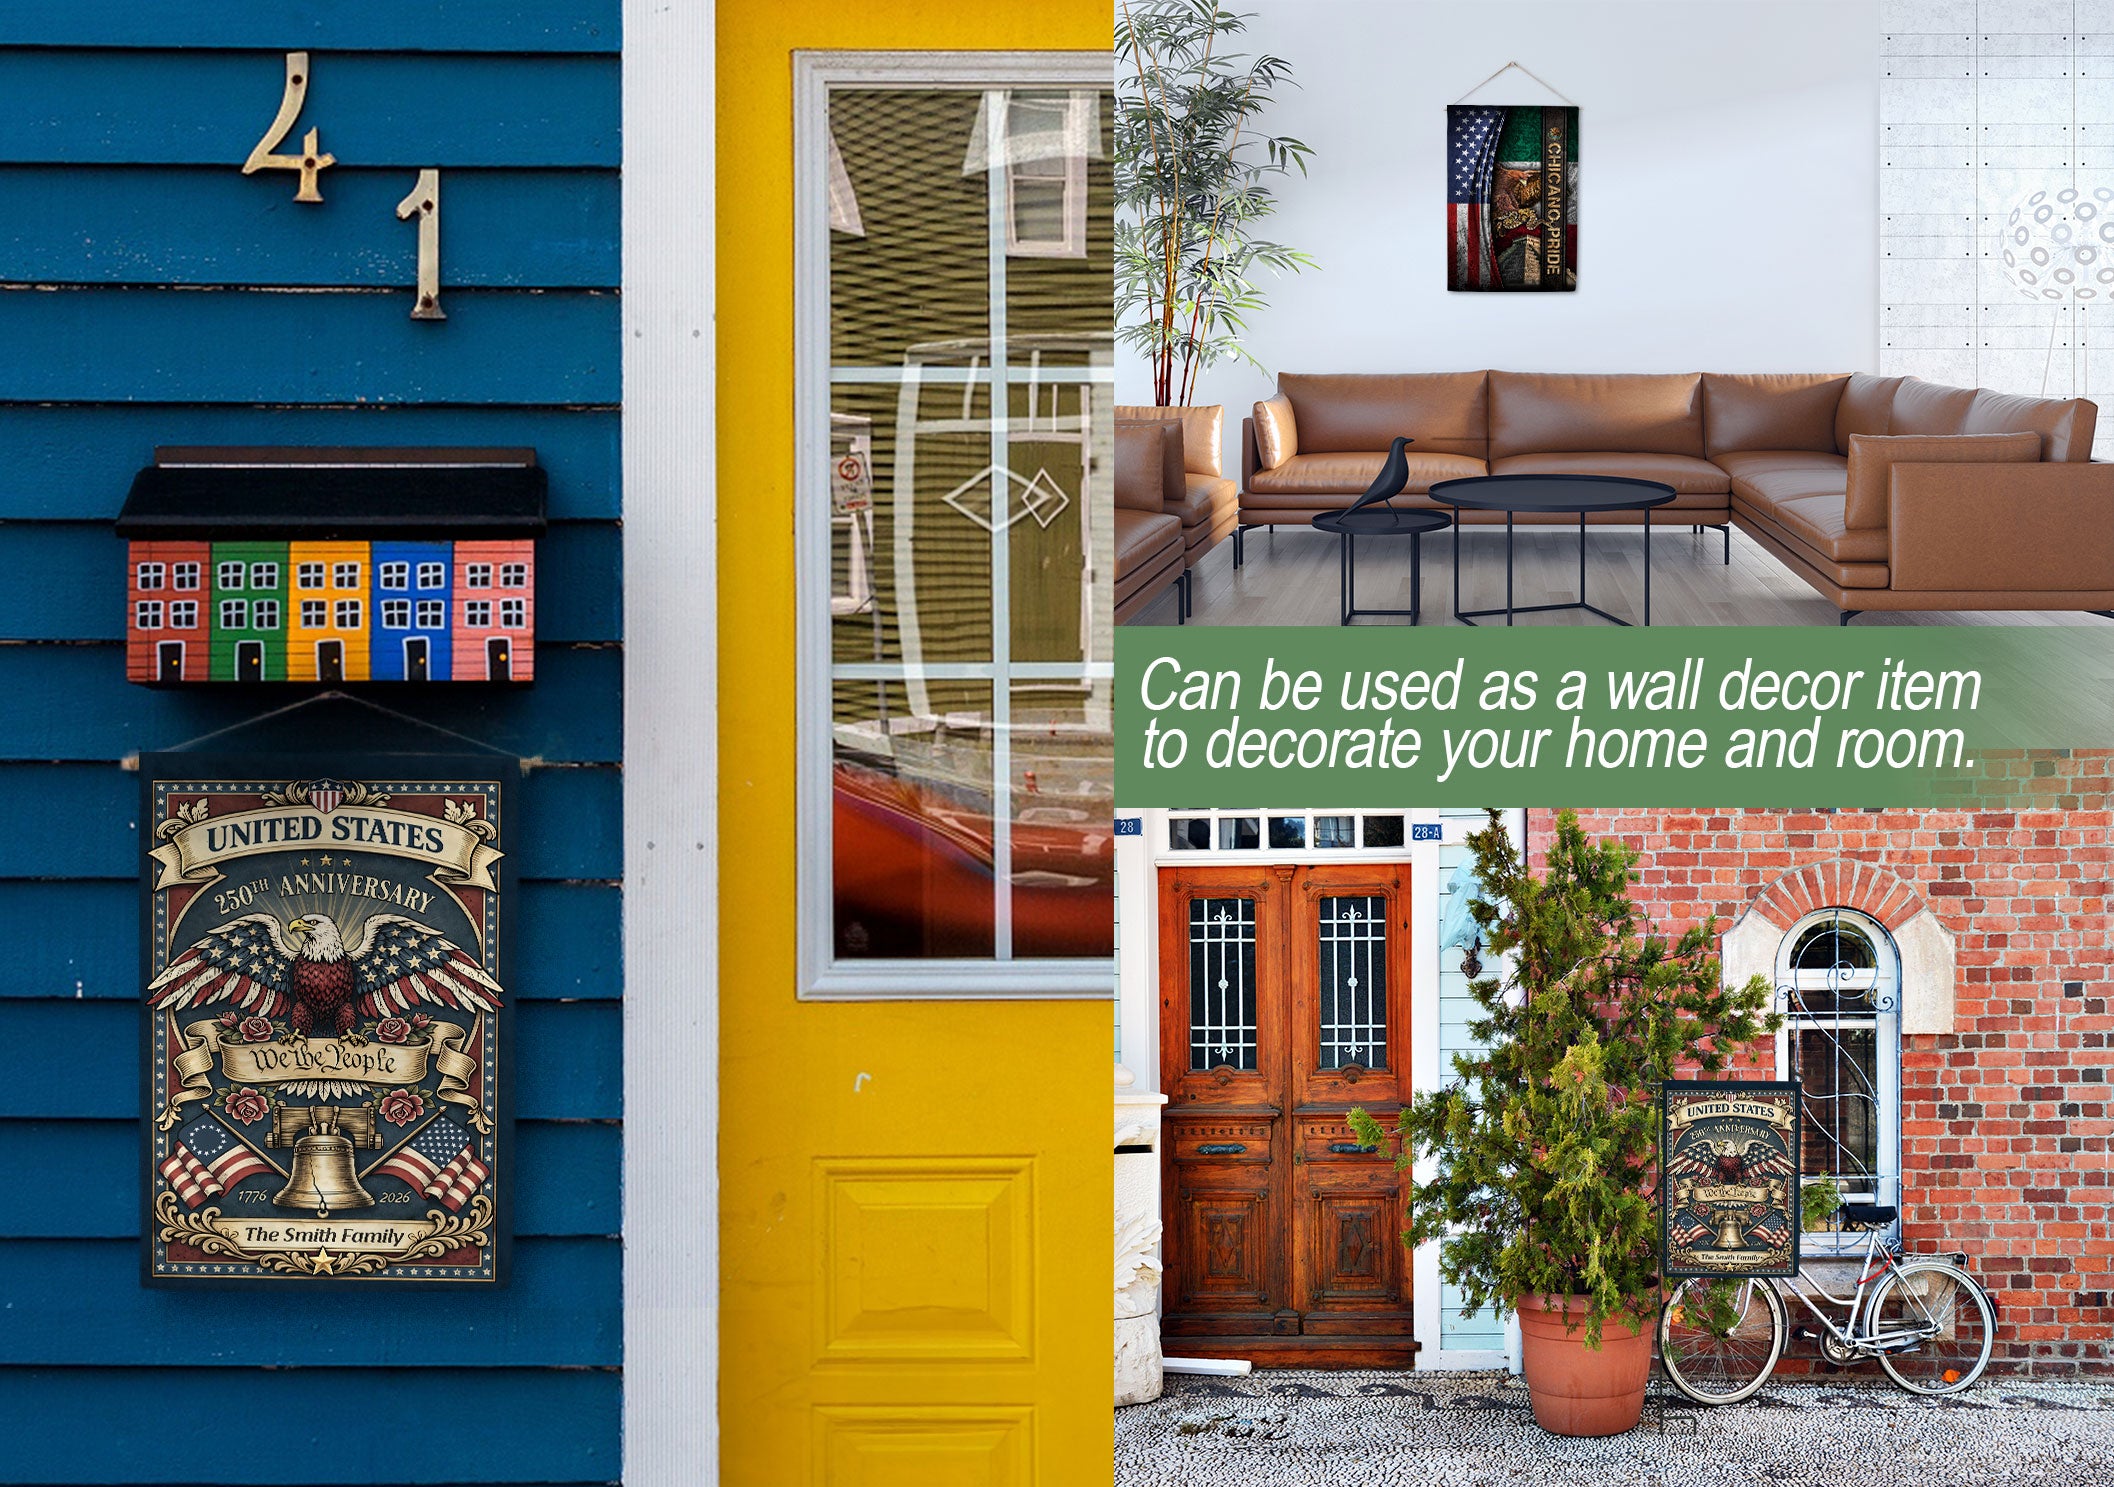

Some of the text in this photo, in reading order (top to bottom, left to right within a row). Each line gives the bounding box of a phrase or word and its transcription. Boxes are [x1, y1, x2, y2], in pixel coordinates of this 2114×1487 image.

[1547, 143, 1561, 275] CHICANO PRIDE
[207, 815, 444, 853] UNITED STATES
[1120, 822, 1134, 833] 28
[1414, 827, 1440, 839] 28-A
[279, 873, 435, 914] ANNIVERSARY
[249, 1046, 291, 1073] We
[320, 1043, 397, 1077] People
[1687, 1103, 1775, 1118] UNITED STATES
[238, 1189, 411, 1204] 1776 2026
[245, 1226, 406, 1247] The Smith Family
[1701, 1253, 1714, 1261] The
